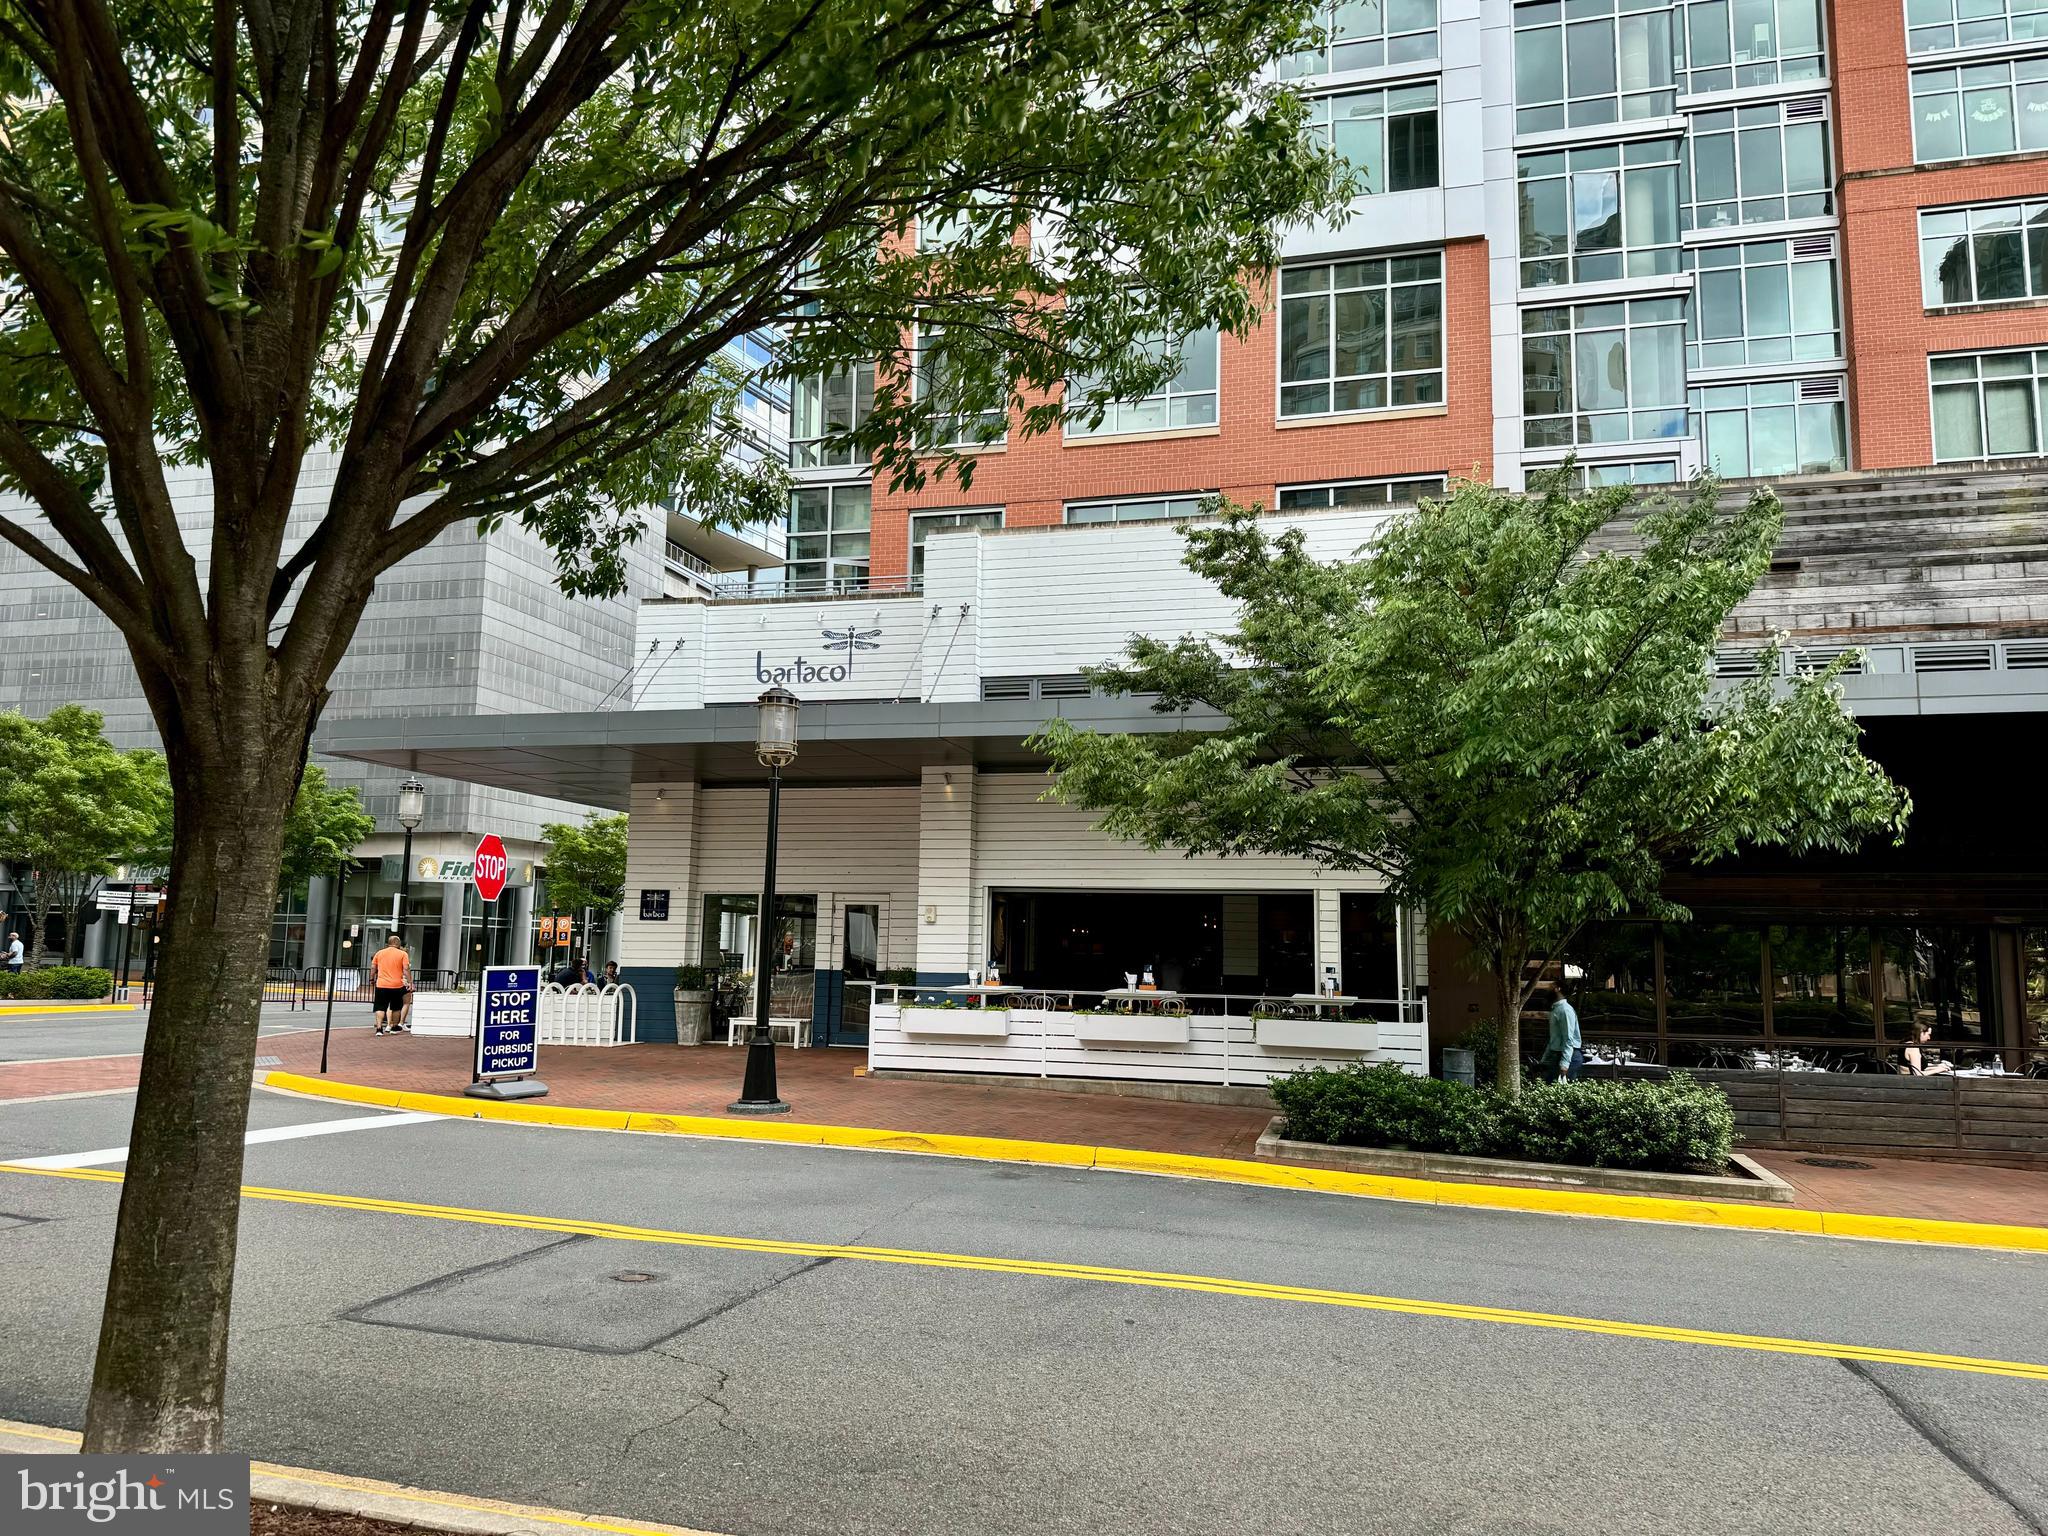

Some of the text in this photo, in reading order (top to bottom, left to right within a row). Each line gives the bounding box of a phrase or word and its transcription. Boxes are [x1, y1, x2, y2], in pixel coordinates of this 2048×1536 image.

[756, 650, 847, 684] bartaco
[440, 861, 516, 882] Fidy
[476, 853, 506, 881] STOP
[643, 907, 666, 918] bartaco
[491, 992, 531, 1008] STOP
[490, 1009, 530, 1025] HERE
[499, 1030, 520, 1041] FOR
[484, 1043, 534, 1056] CURBSIDE
[491, 1057, 528, 1069] PICKUP
